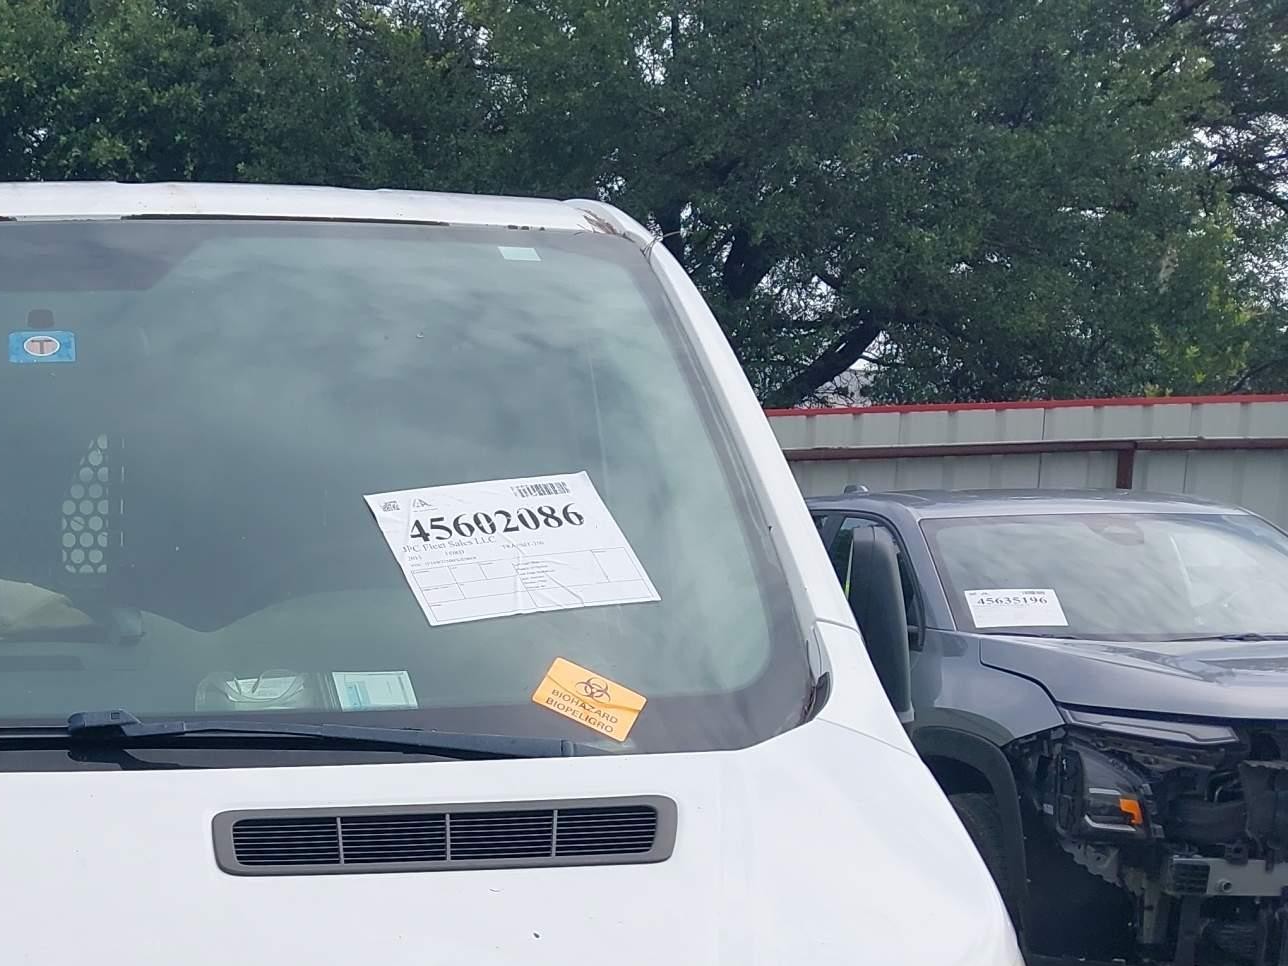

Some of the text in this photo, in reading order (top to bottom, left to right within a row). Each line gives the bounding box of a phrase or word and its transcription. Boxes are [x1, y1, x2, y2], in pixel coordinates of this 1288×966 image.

[409, 502, 585, 542] 45602086
[448, 540, 473, 550] Sales
[475, 536, 497, 545] LLC
[977, 596, 1048, 605] 45635196
[545, 696, 614, 733] BIOPELIGRO
[551, 687, 619, 724] BIOHAZARD
